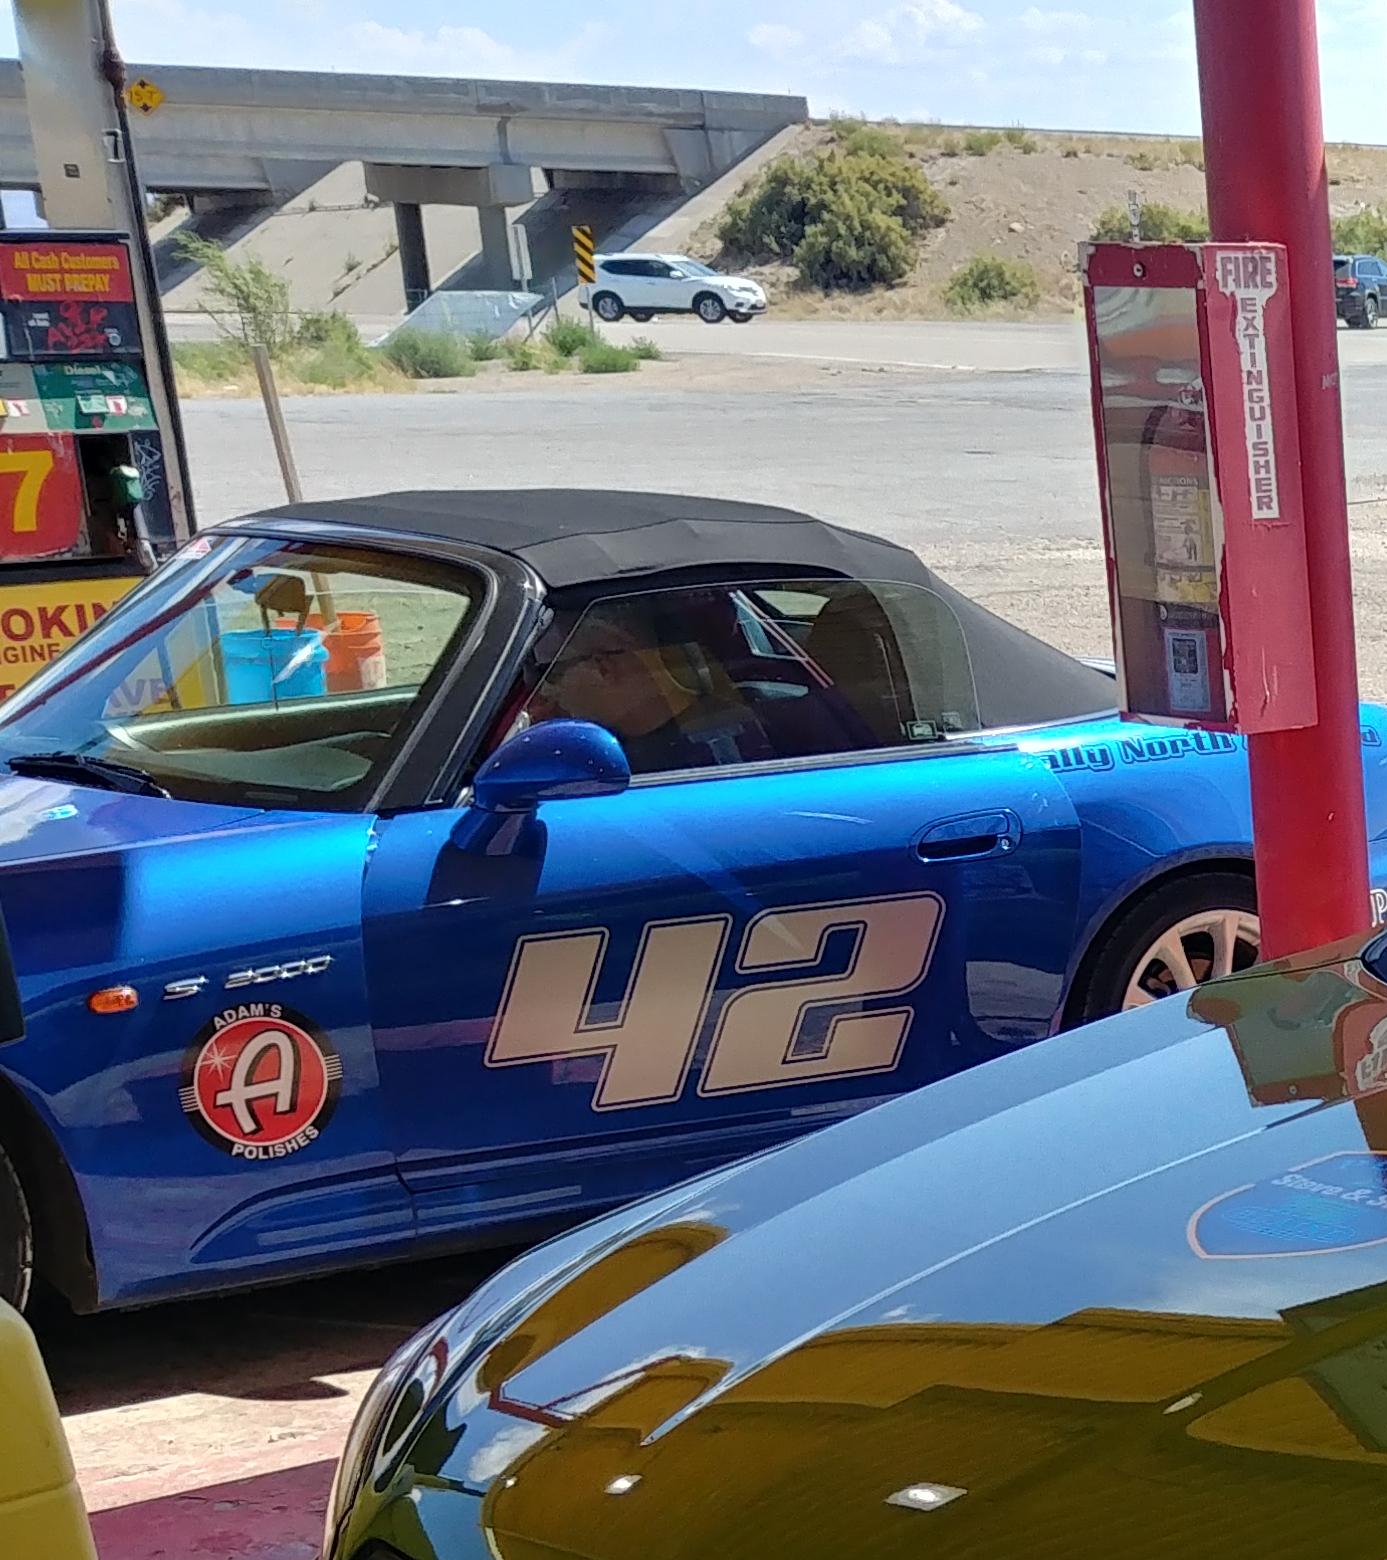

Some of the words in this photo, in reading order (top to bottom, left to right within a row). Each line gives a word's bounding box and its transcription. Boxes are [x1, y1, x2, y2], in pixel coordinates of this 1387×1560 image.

[31, 252, 59, 270] Cash
[61, 252, 120, 271] Customers
[1219, 256, 1274, 290] FIRE
[26, 274, 62, 293] MUST
[65, 274, 110, 293] PREPAY
[1239, 297, 1275, 512] EXTINGUISHER
[0, 450, 53, 533] 7
[0, 643, 60, 664] GINE
[1118, 733, 1236, 764] North
[163, 976, 209, 1000] S
[224, 955, 335, 989] 2000
[213, 1003, 283, 1031] ADAM'S
[483, 891, 946, 1112] 42
[216, 1029, 298, 1136] A
[232, 1125, 320, 1160] POLISHES
[1272, 1172, 1344, 1198] Steve
[1343, 1187, 1371, 1204] &
